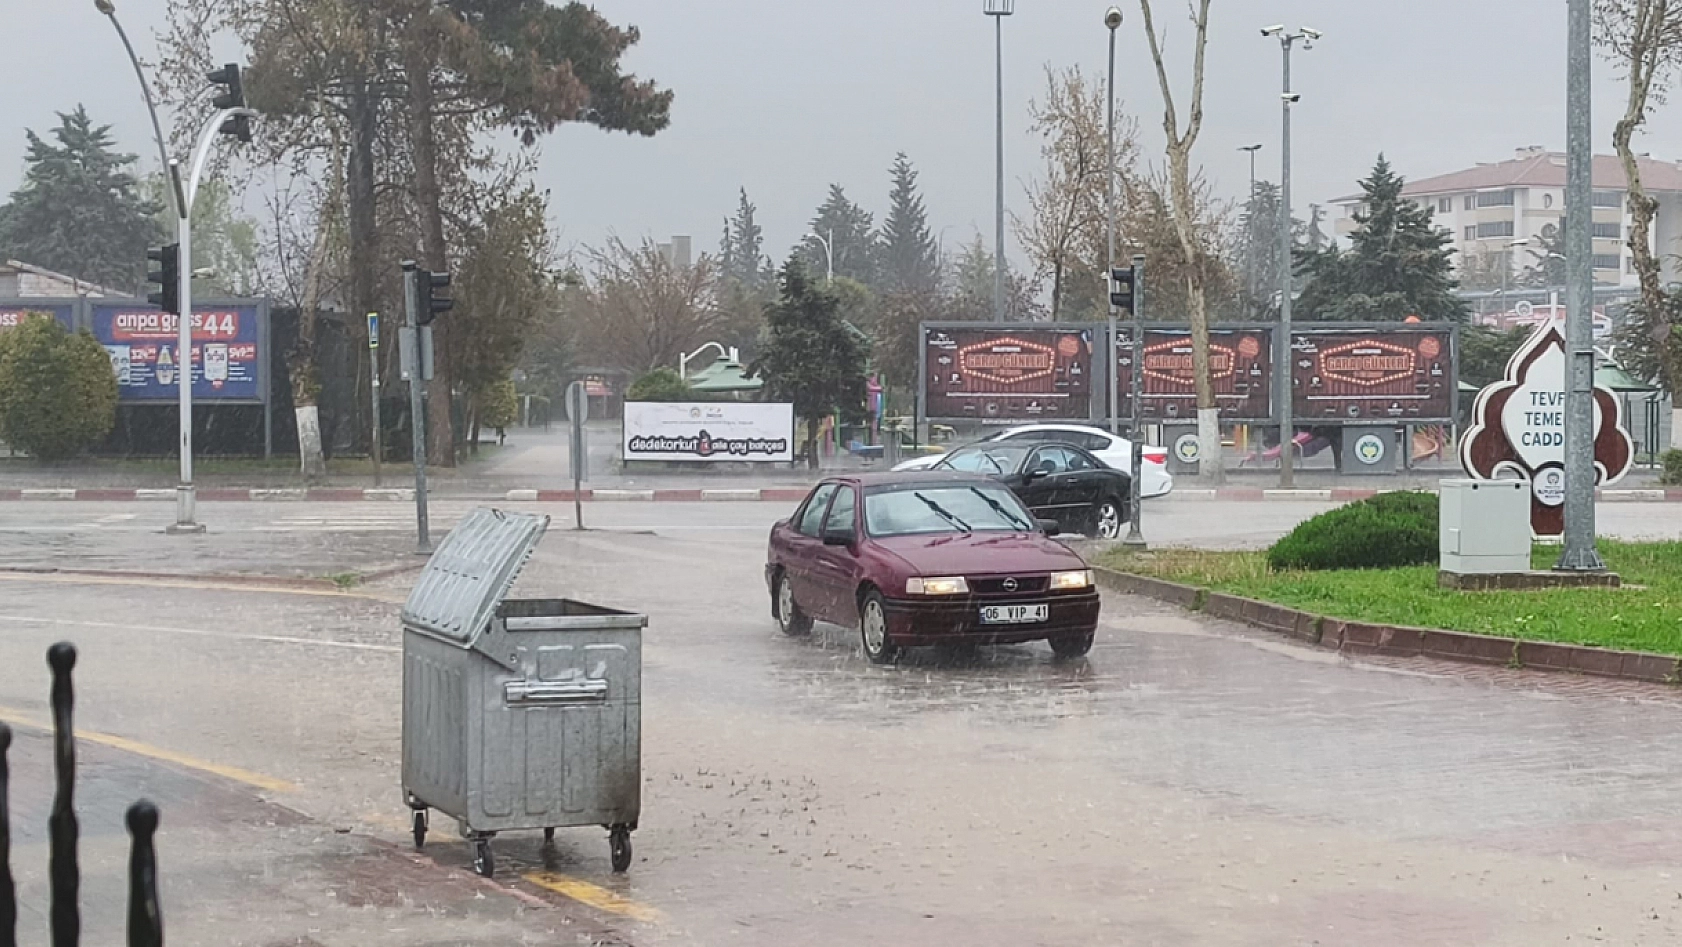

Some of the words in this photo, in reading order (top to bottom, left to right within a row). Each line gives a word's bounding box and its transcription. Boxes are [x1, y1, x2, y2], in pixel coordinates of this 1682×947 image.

[117, 314, 159, 332] anpa
[161, 314, 203, 332] grss
[203, 314, 236, 335] 44
[1529, 391, 1565, 406] TEVF
[1524, 412, 1563, 426] TEME
[630, 437, 699, 451] dedekorkut
[730, 441, 748, 454] çay
[748, 438, 785, 454] bahçesi
[1521, 432, 1563, 446] CADD
[985, 608, 999, 619] 06
[1007, 606, 1027, 618] VIP
[1035, 605, 1047, 617] 41
